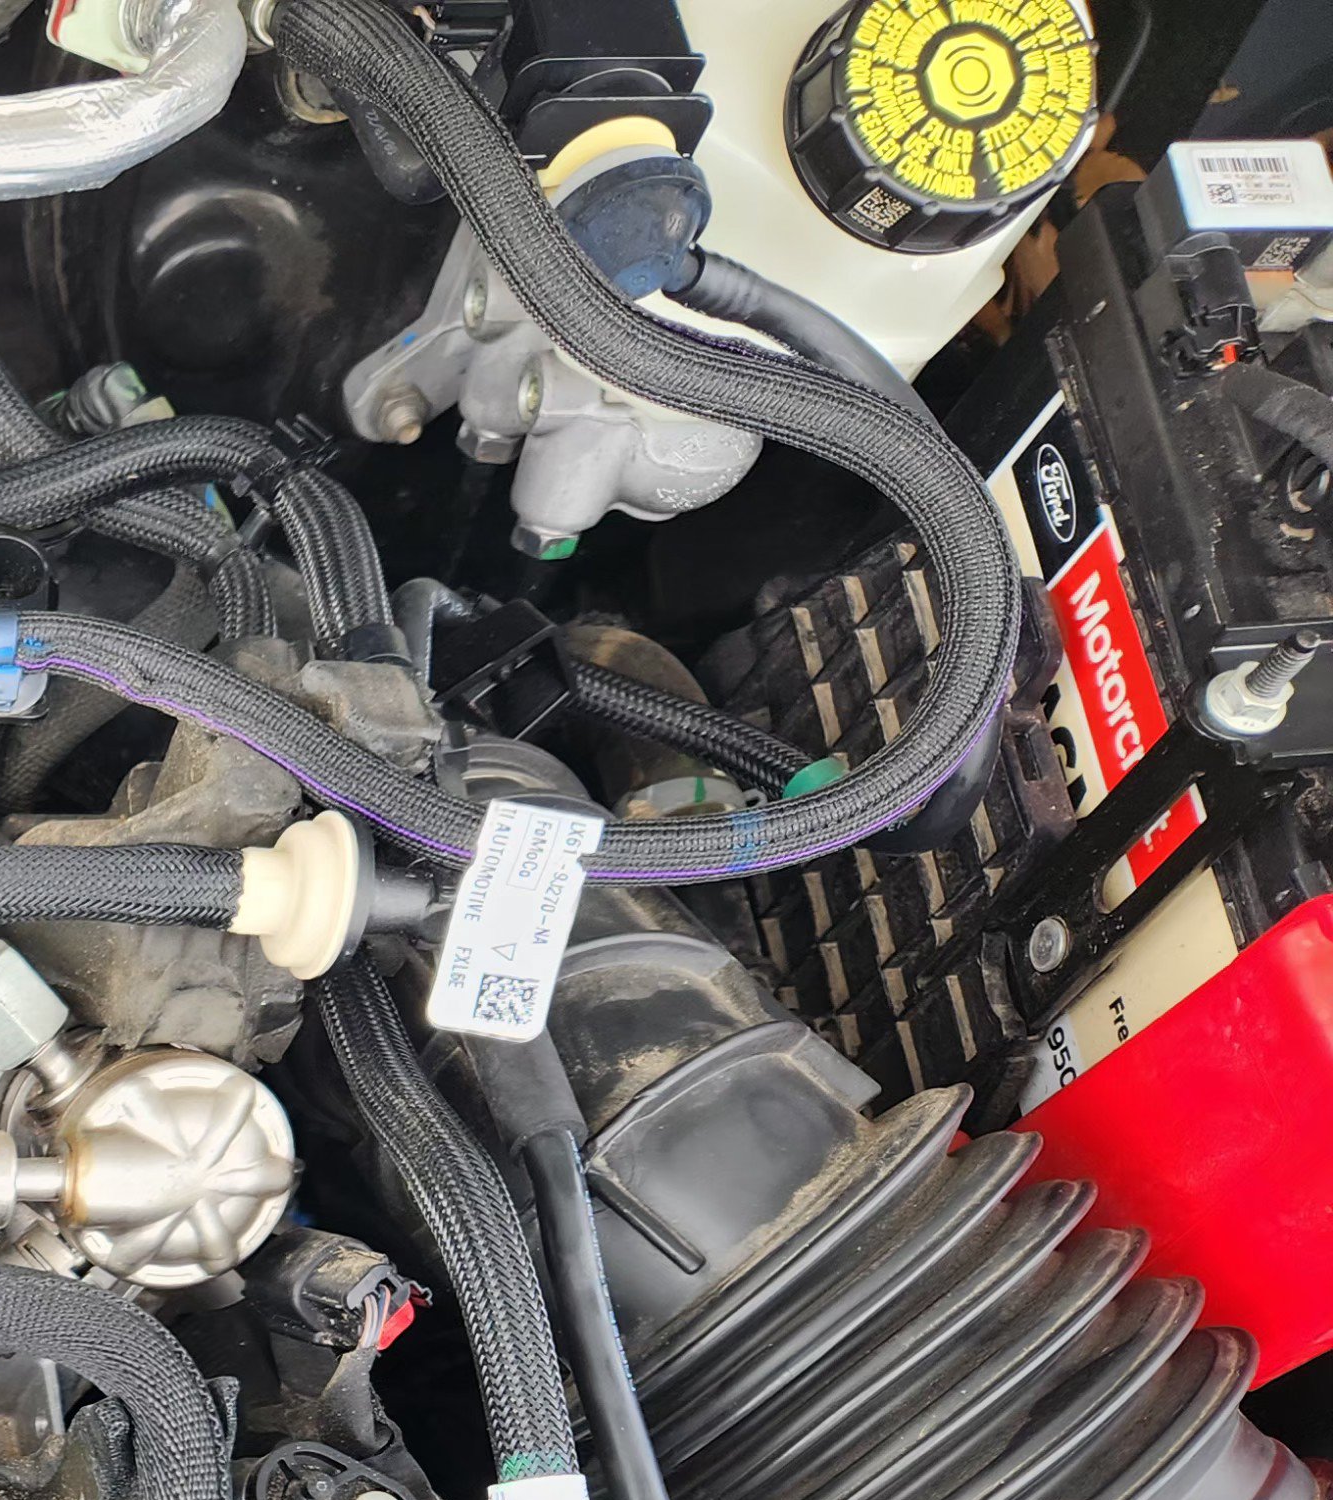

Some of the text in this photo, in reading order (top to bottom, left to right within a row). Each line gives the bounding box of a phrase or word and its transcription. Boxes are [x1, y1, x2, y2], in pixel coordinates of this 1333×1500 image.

[872, 9, 915, 65] BEFORE
[1034, 22, 1061, 50] DU
[1061, 22, 1085, 47] LE
[894, 7, 974, 153] WARNING CLEAN FILLER
[1043, 44, 1070, 95] LIQUIDE
[1067, 47, 1091, 113] BOUCHON
[846, 2, 975, 200] FLUID FROM A SEALED CONTAINER
[871, 67, 914, 139] REMOVING
[1018, 75, 1048, 117] BIDON
[1042, 95, 1066, 115] DE
[903, 131, 935, 162] USE
[1022, 112, 1058, 152] FREIN
[1046, 111, 1082, 160] AVANT
[933, 148, 973, 176] ONLY
[464, 822, 511, 922] AUTOMOTIVE
[518, 819, 553, 879] FoMoCo
